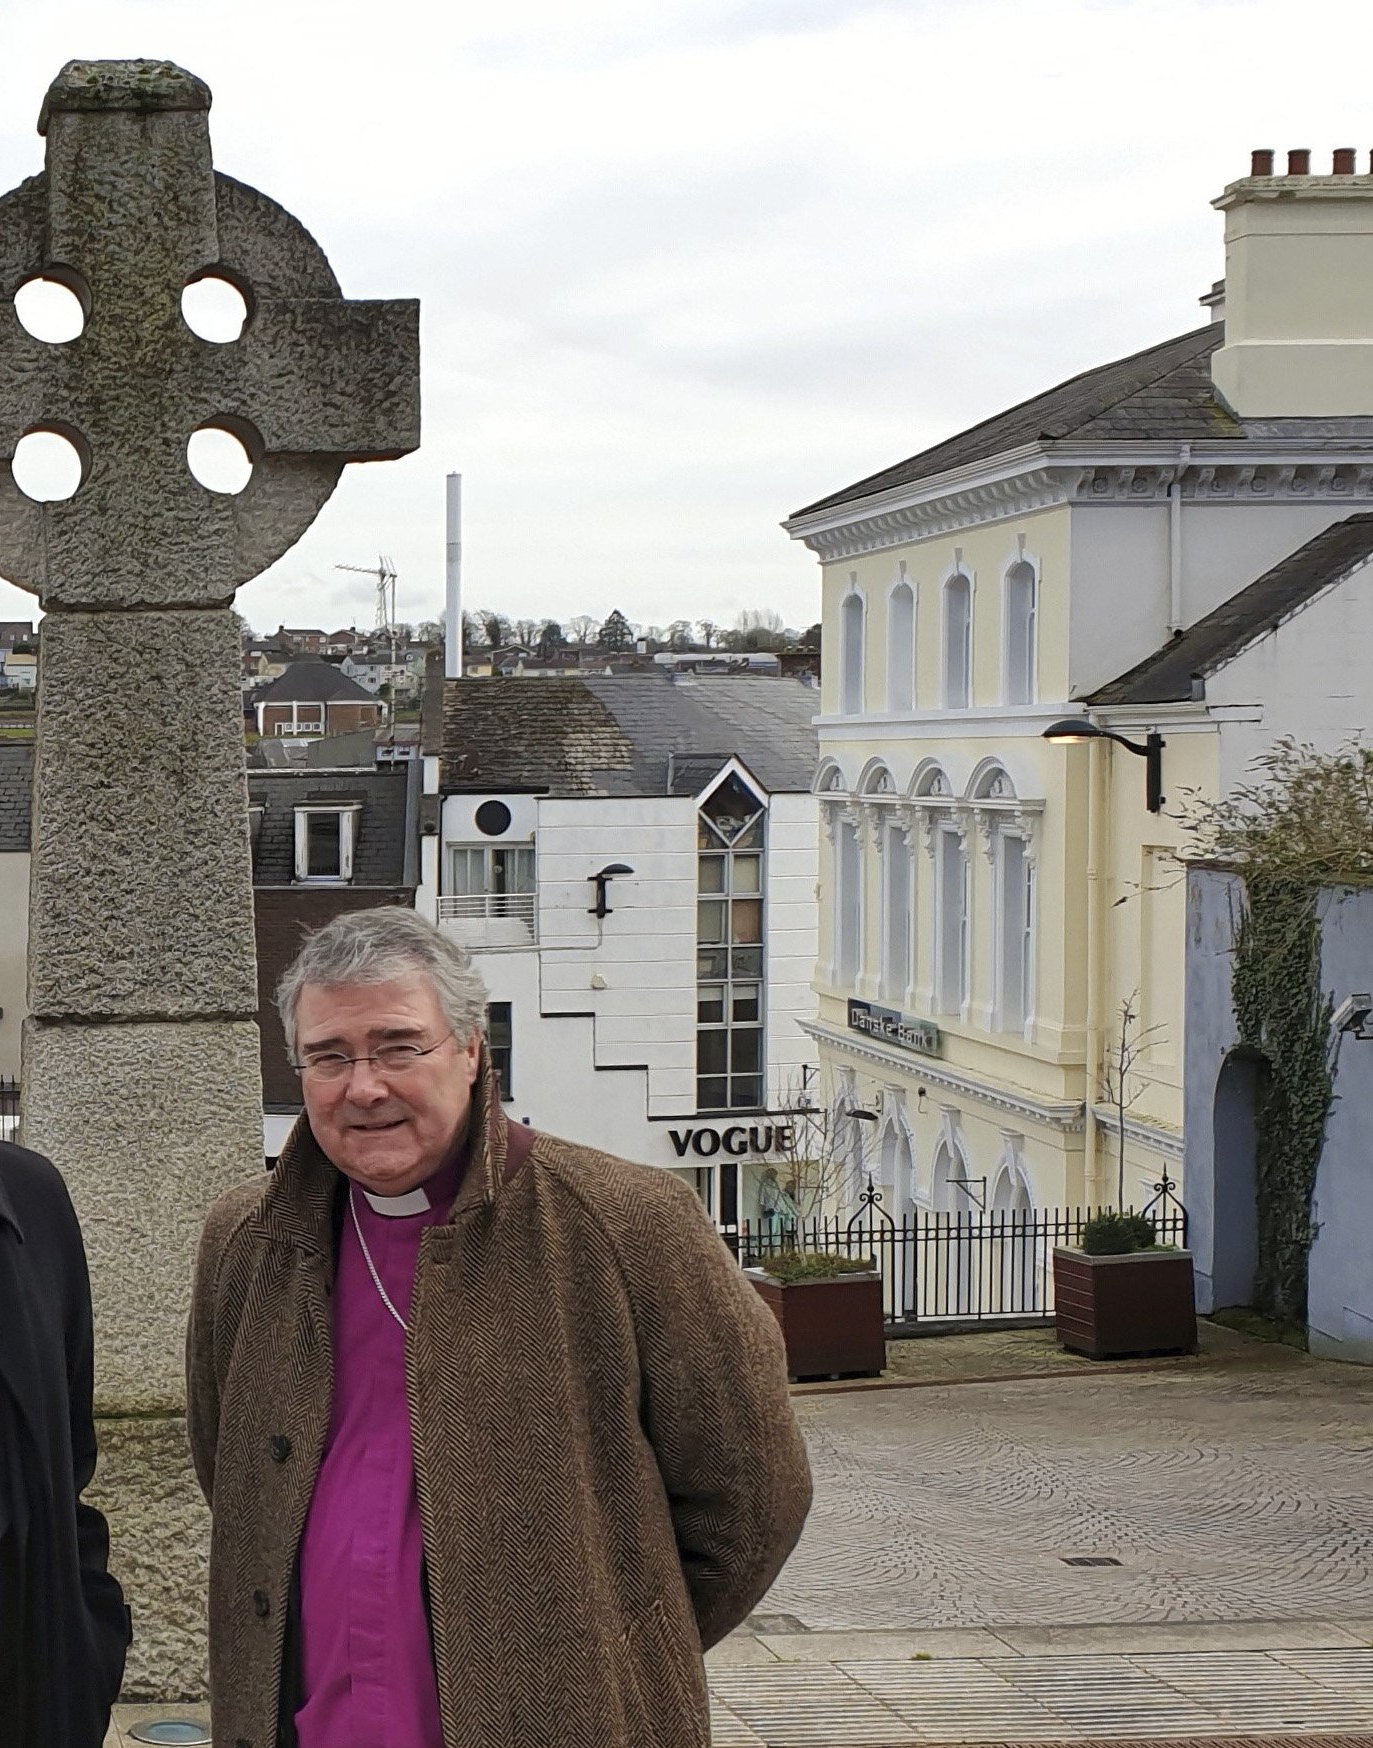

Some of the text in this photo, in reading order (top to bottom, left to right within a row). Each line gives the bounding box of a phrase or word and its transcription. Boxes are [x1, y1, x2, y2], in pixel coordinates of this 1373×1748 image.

[851, 1008, 931, 1049] Danske Bank
[668, 1126, 796, 1157] VOGUE
